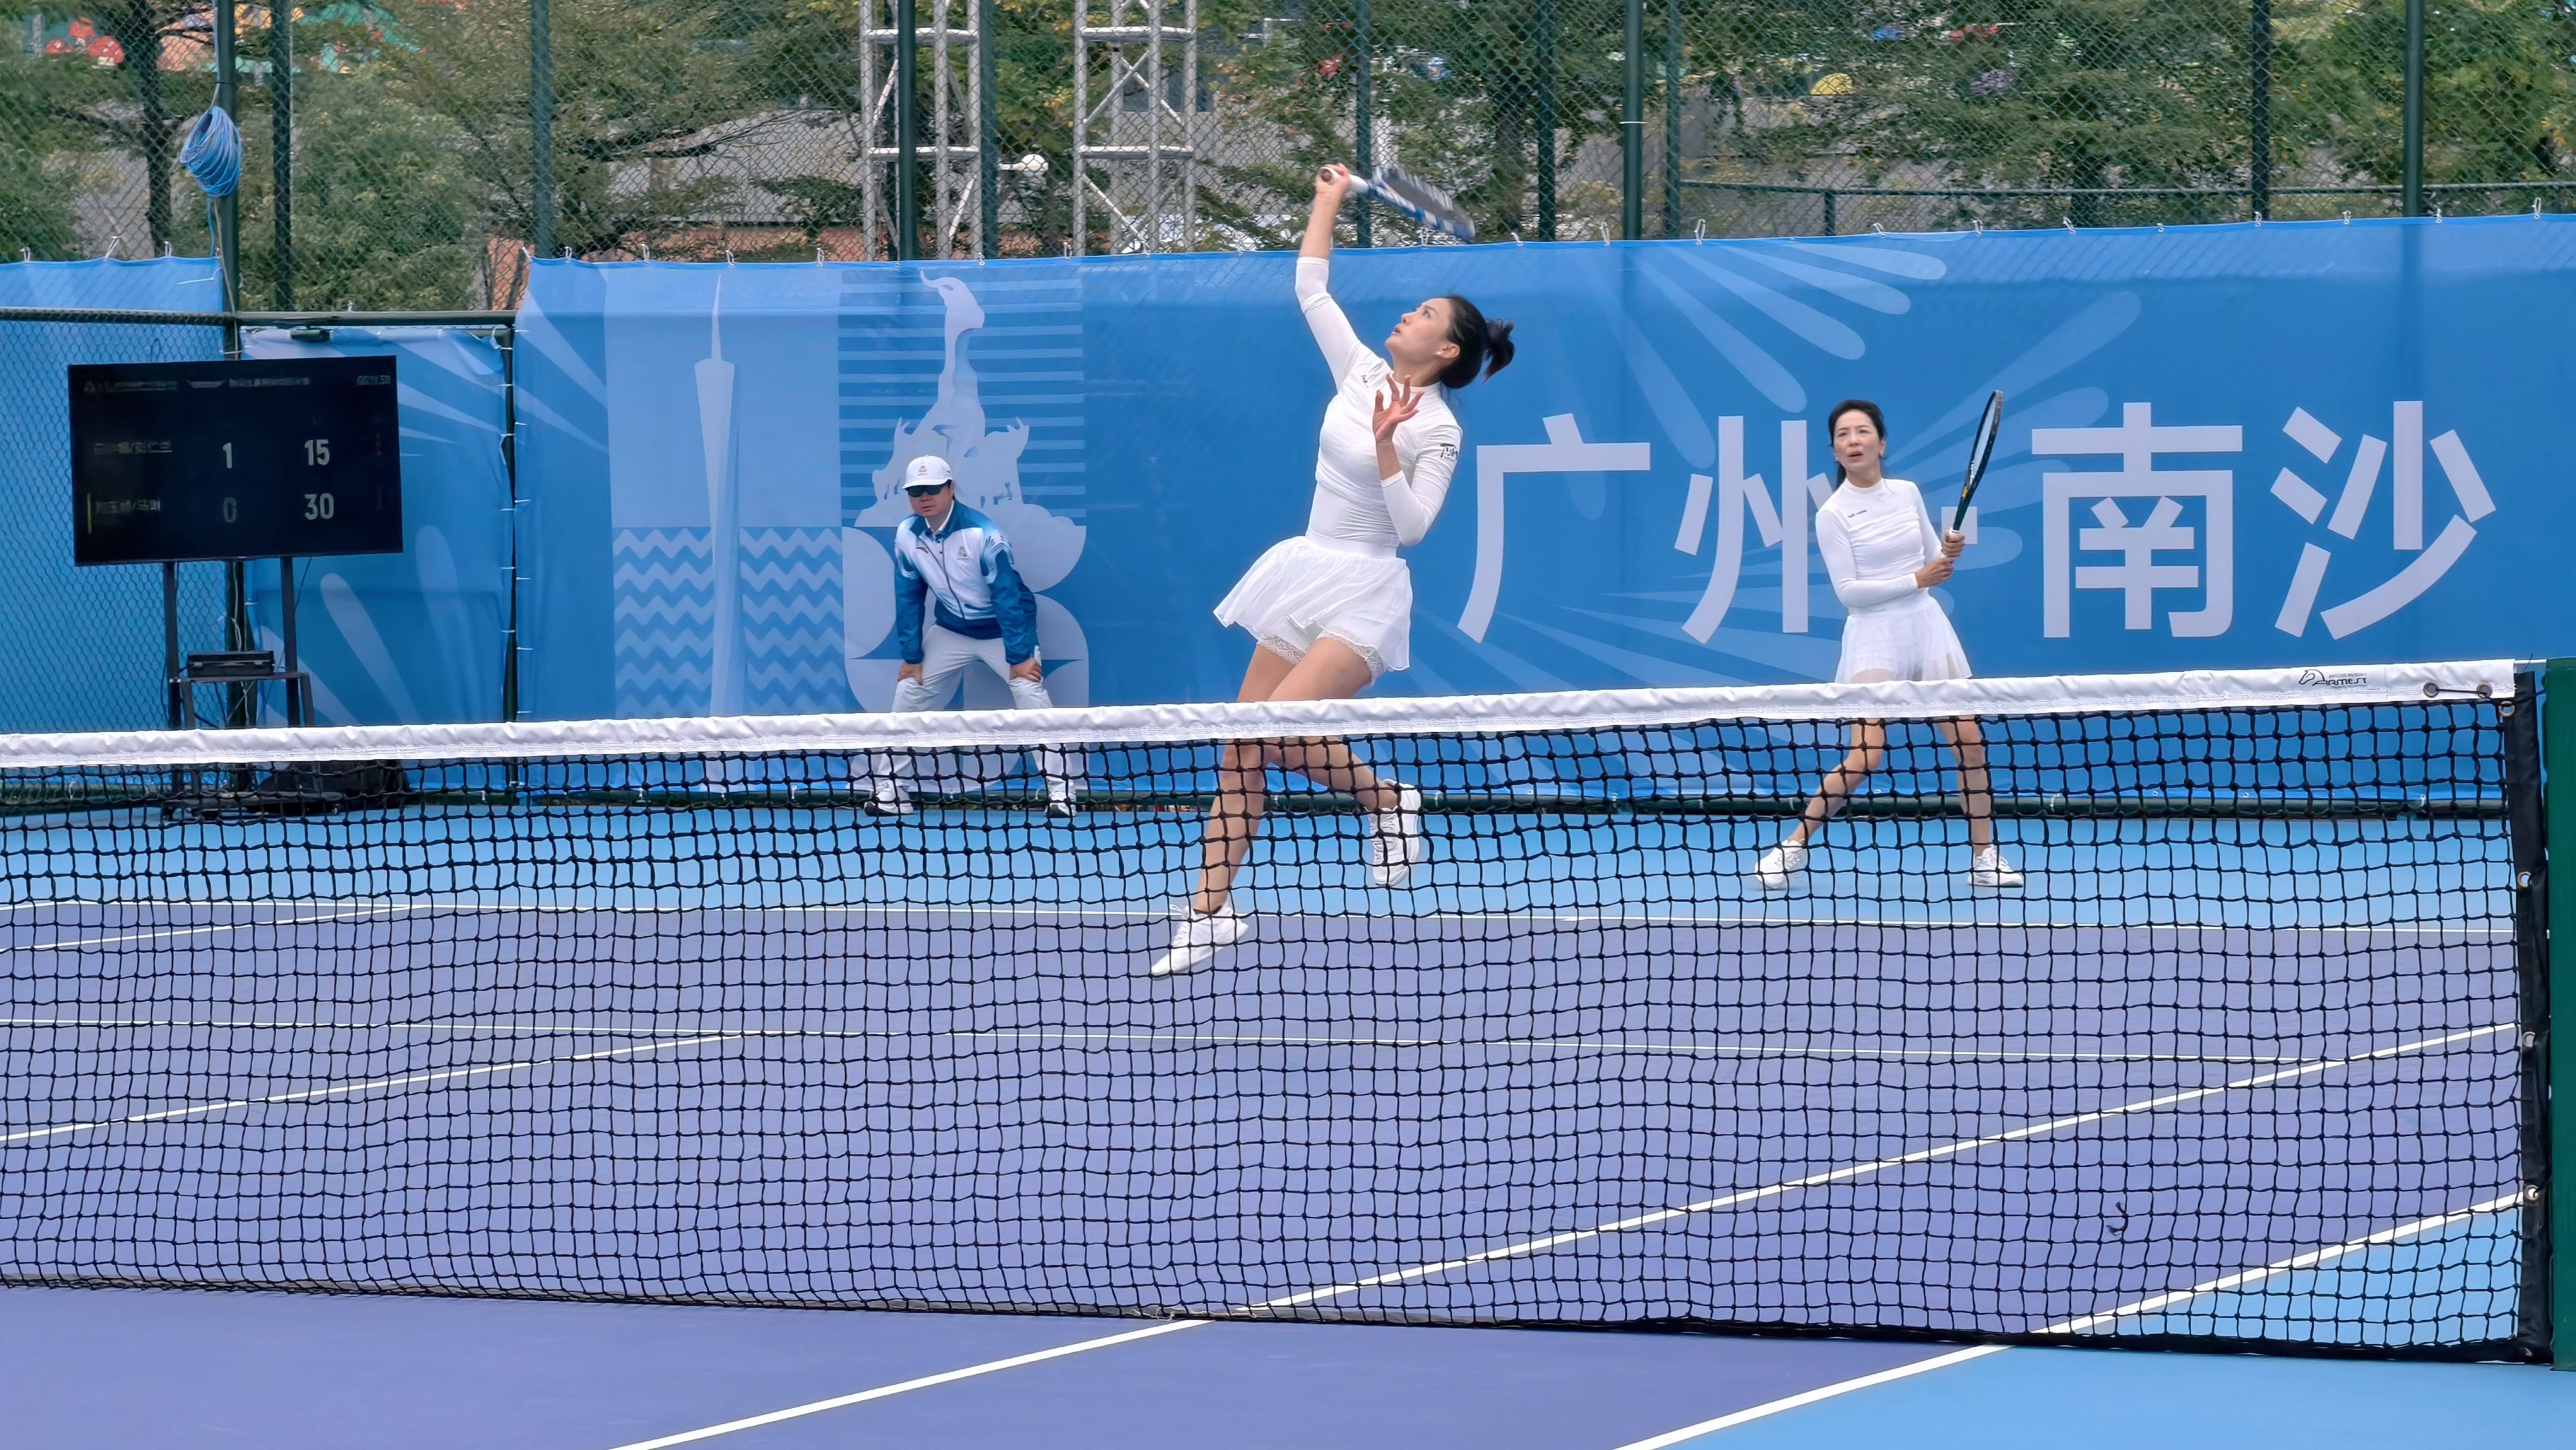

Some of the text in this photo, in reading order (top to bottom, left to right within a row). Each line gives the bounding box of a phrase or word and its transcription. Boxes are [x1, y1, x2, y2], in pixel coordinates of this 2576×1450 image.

[223, 440, 330, 469] 1 15
[304, 493, 334, 520] 30
